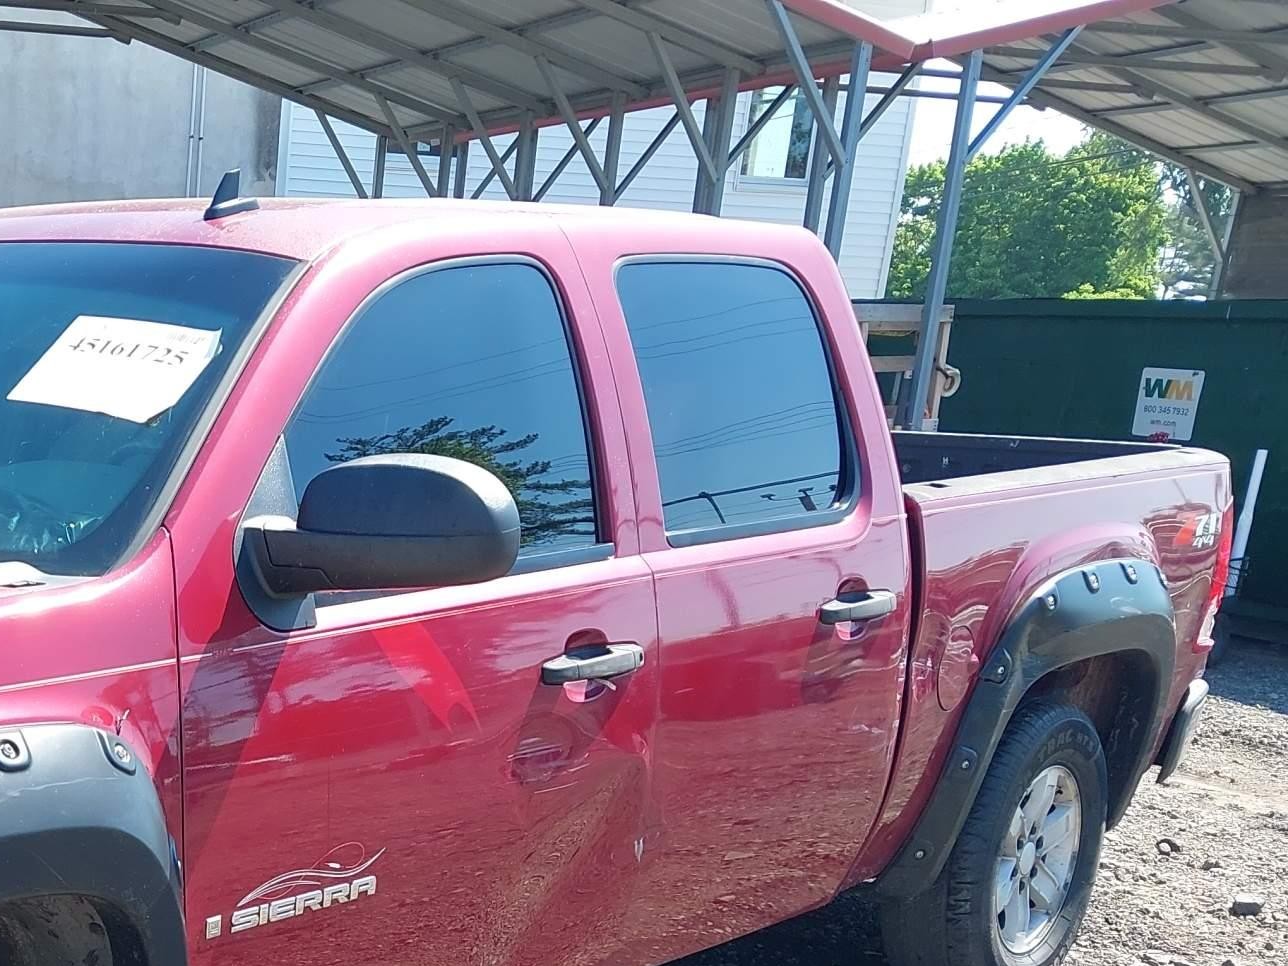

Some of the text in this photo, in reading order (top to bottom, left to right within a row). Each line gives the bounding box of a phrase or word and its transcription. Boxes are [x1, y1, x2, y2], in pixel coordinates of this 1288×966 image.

[68, 336, 190, 366] 45161725
[1144, 377, 1193, 401] WM
[1143, 404, 1157, 414] 800
[1157, 405, 1172, 416] 345
[230, 875, 377, 934] SIERRA
